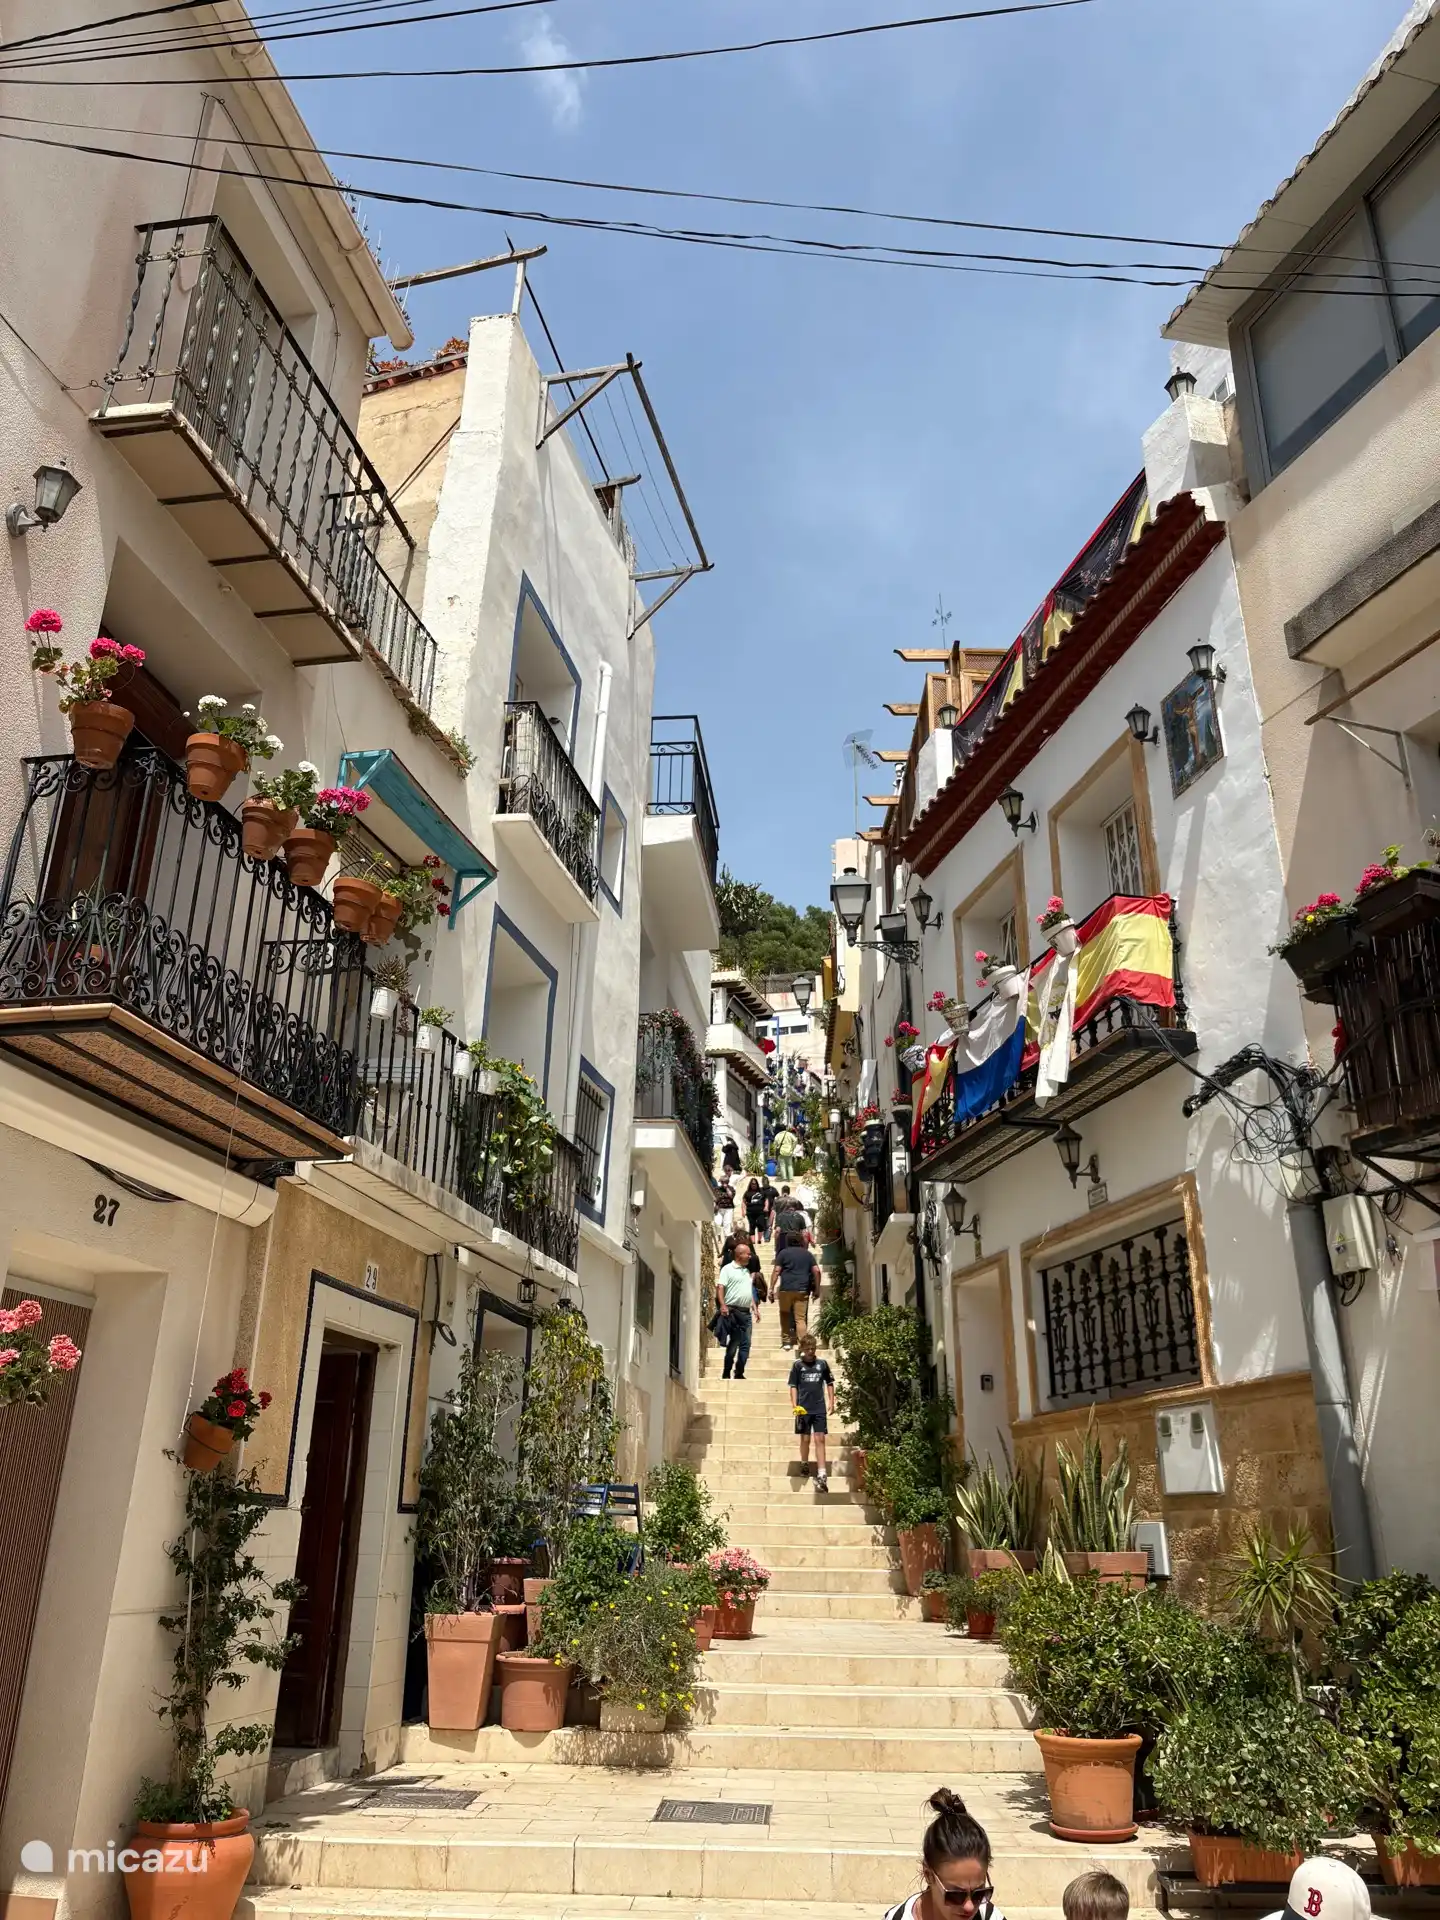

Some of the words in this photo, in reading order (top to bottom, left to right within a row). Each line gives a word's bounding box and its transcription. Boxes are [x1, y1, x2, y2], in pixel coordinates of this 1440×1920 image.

[93, 1194, 120, 1227] 27
[366, 1265, 378, 1290] 29
[1304, 1887, 1323, 1917] B
